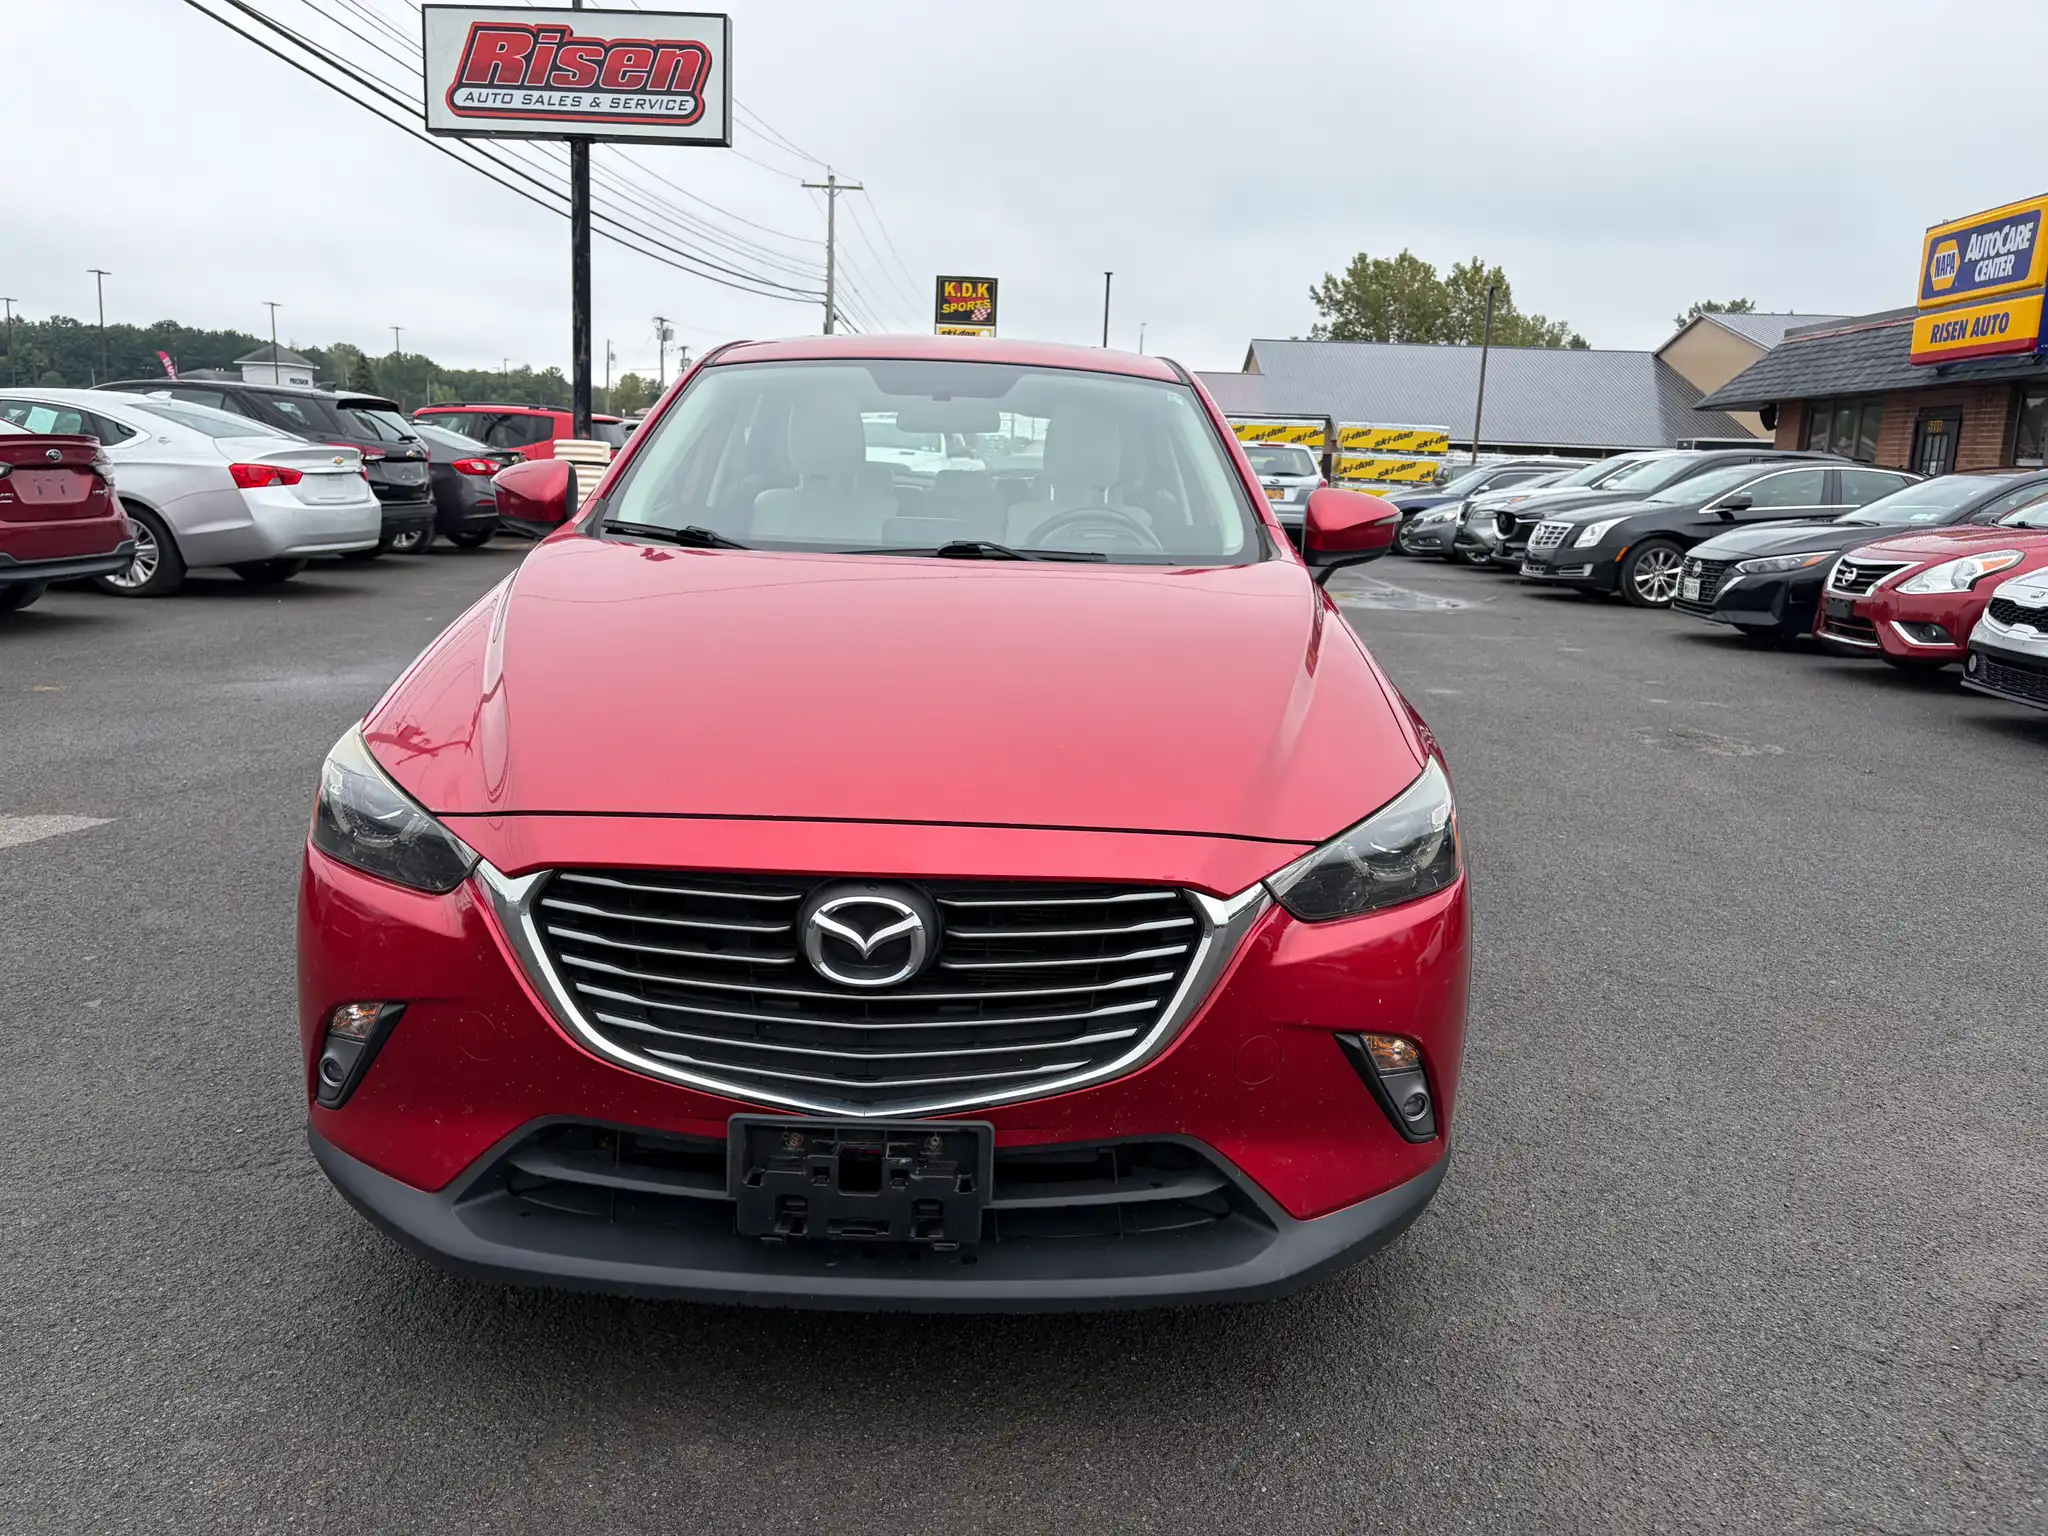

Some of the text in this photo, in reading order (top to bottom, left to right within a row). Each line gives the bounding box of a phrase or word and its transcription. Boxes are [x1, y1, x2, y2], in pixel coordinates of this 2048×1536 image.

[462, 29, 704, 92] Risen
[462, 92, 690, 111] AUTO SALES & SERVICE
[1934, 251, 1956, 278] NAPA
[1974, 254, 2015, 283] CENTER
[942, 300, 991, 313] SPORTS
[1929, 312, 2010, 344] RISEN AUTO
[1374, 431, 1413, 448] ski-doo
[1377, 462, 1416, 478] ski-doo
